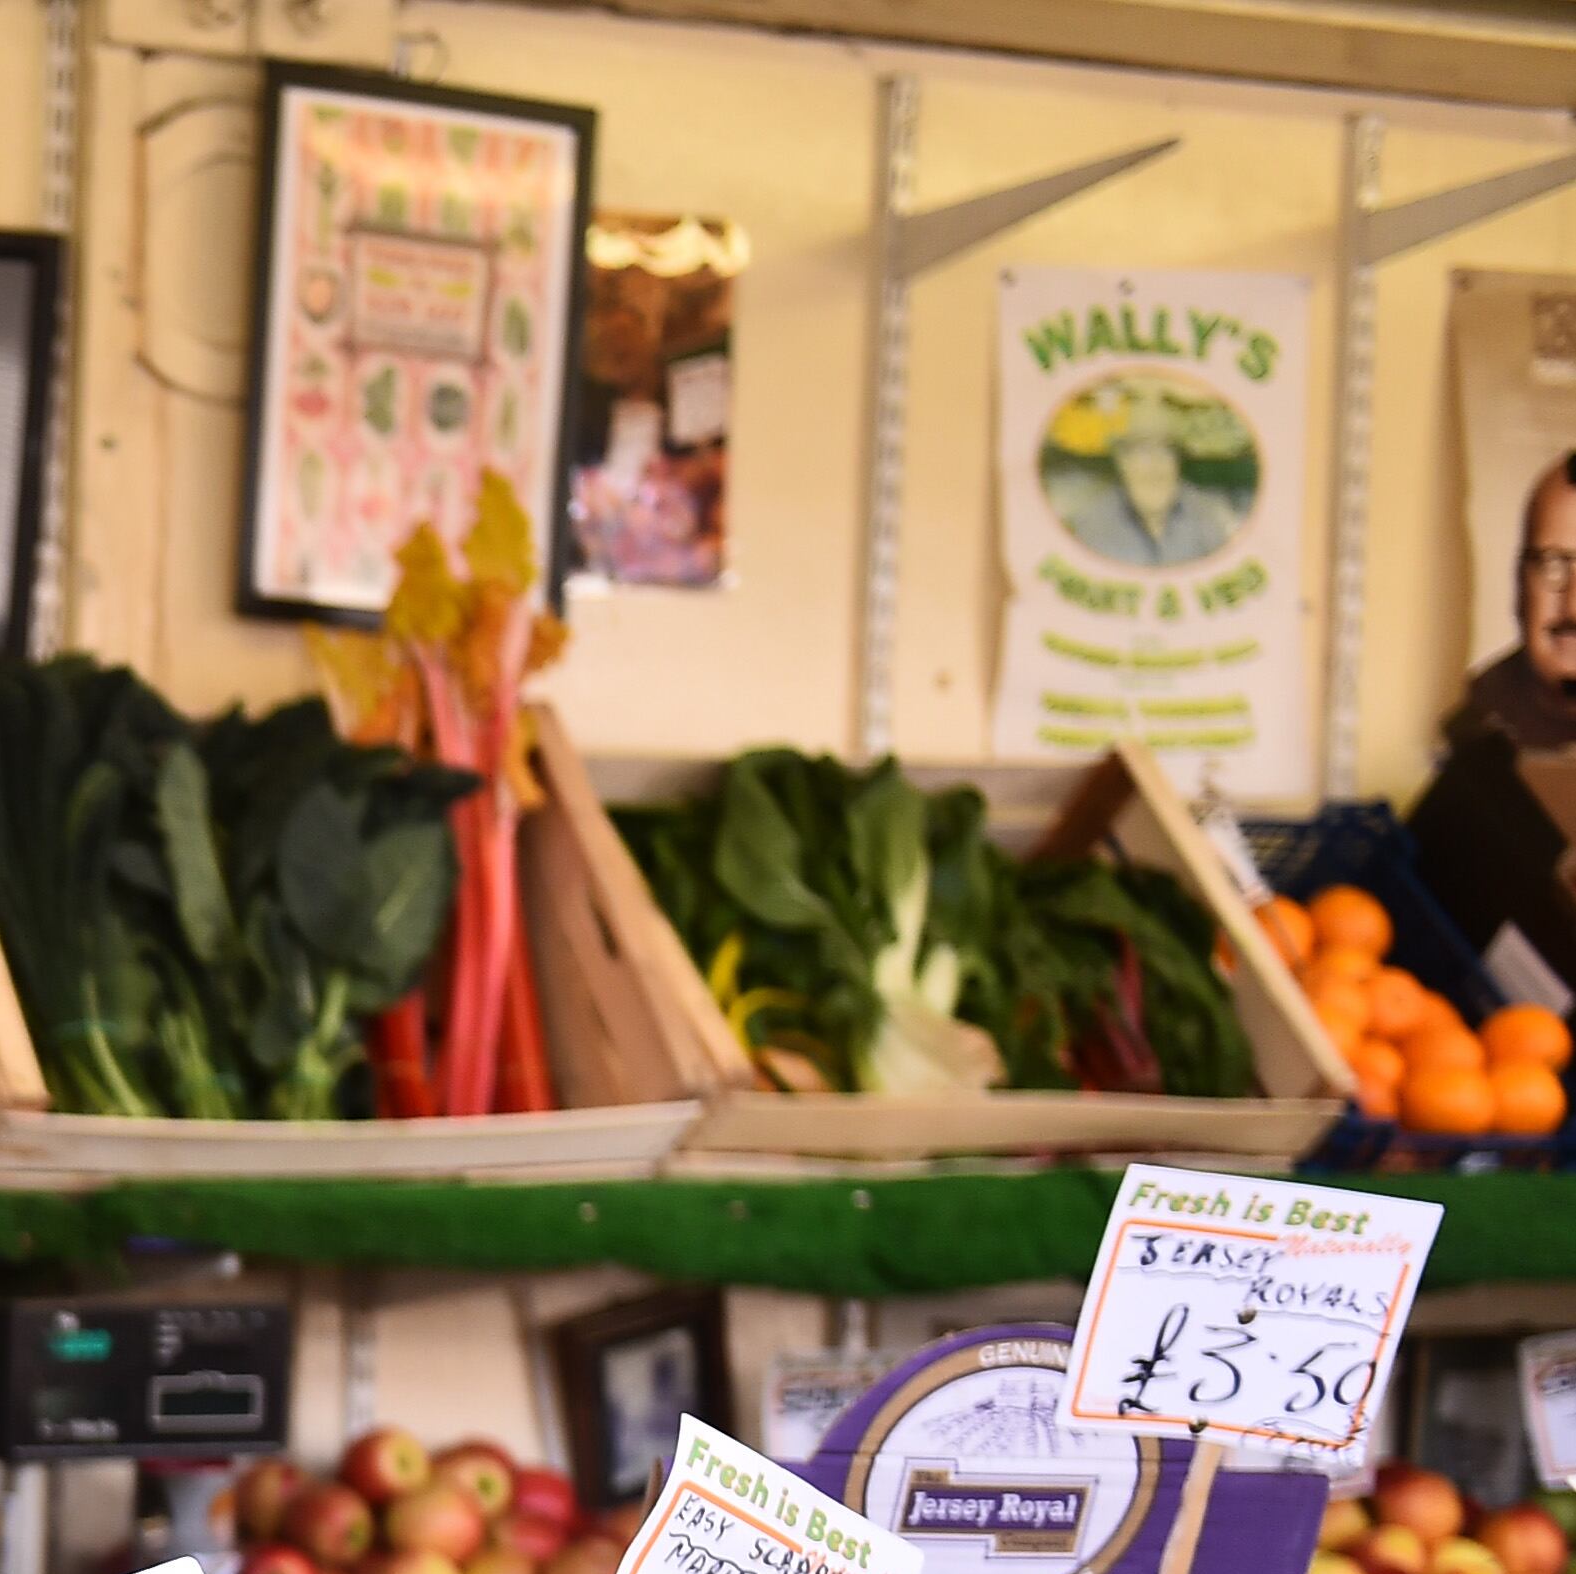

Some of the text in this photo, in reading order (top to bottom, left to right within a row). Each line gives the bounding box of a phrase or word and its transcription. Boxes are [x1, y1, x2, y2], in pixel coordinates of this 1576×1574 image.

[1128, 1181, 1372, 1236] Fresh is Best
[977, 1340, 1071, 1368] GENUIN
[686, 1436, 873, 1570] Fresh is Best
[908, 1491, 1079, 1528] Jersey Royal
